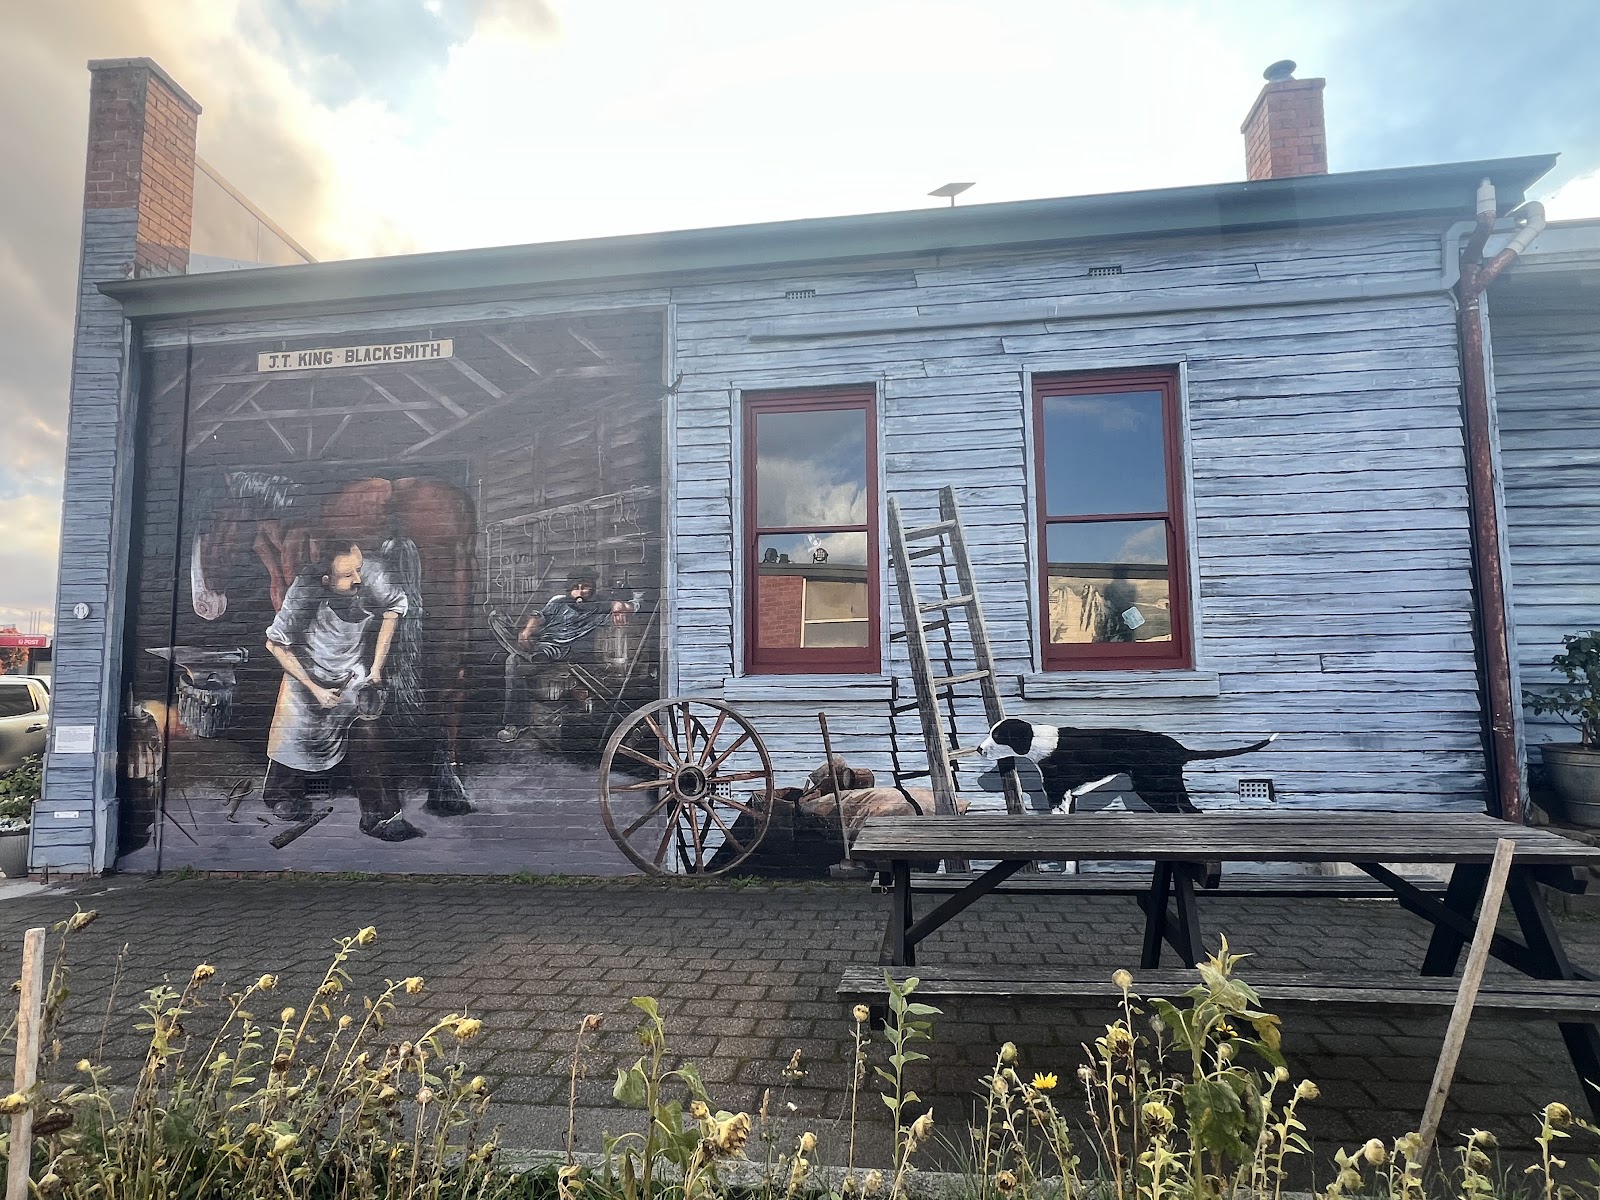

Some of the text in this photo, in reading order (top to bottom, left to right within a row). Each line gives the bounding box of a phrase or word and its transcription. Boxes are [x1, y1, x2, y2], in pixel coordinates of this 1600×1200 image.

[268, 343, 441, 369] J.T. KING BLACKSMITH
[76, 606, 85, 615] 11
